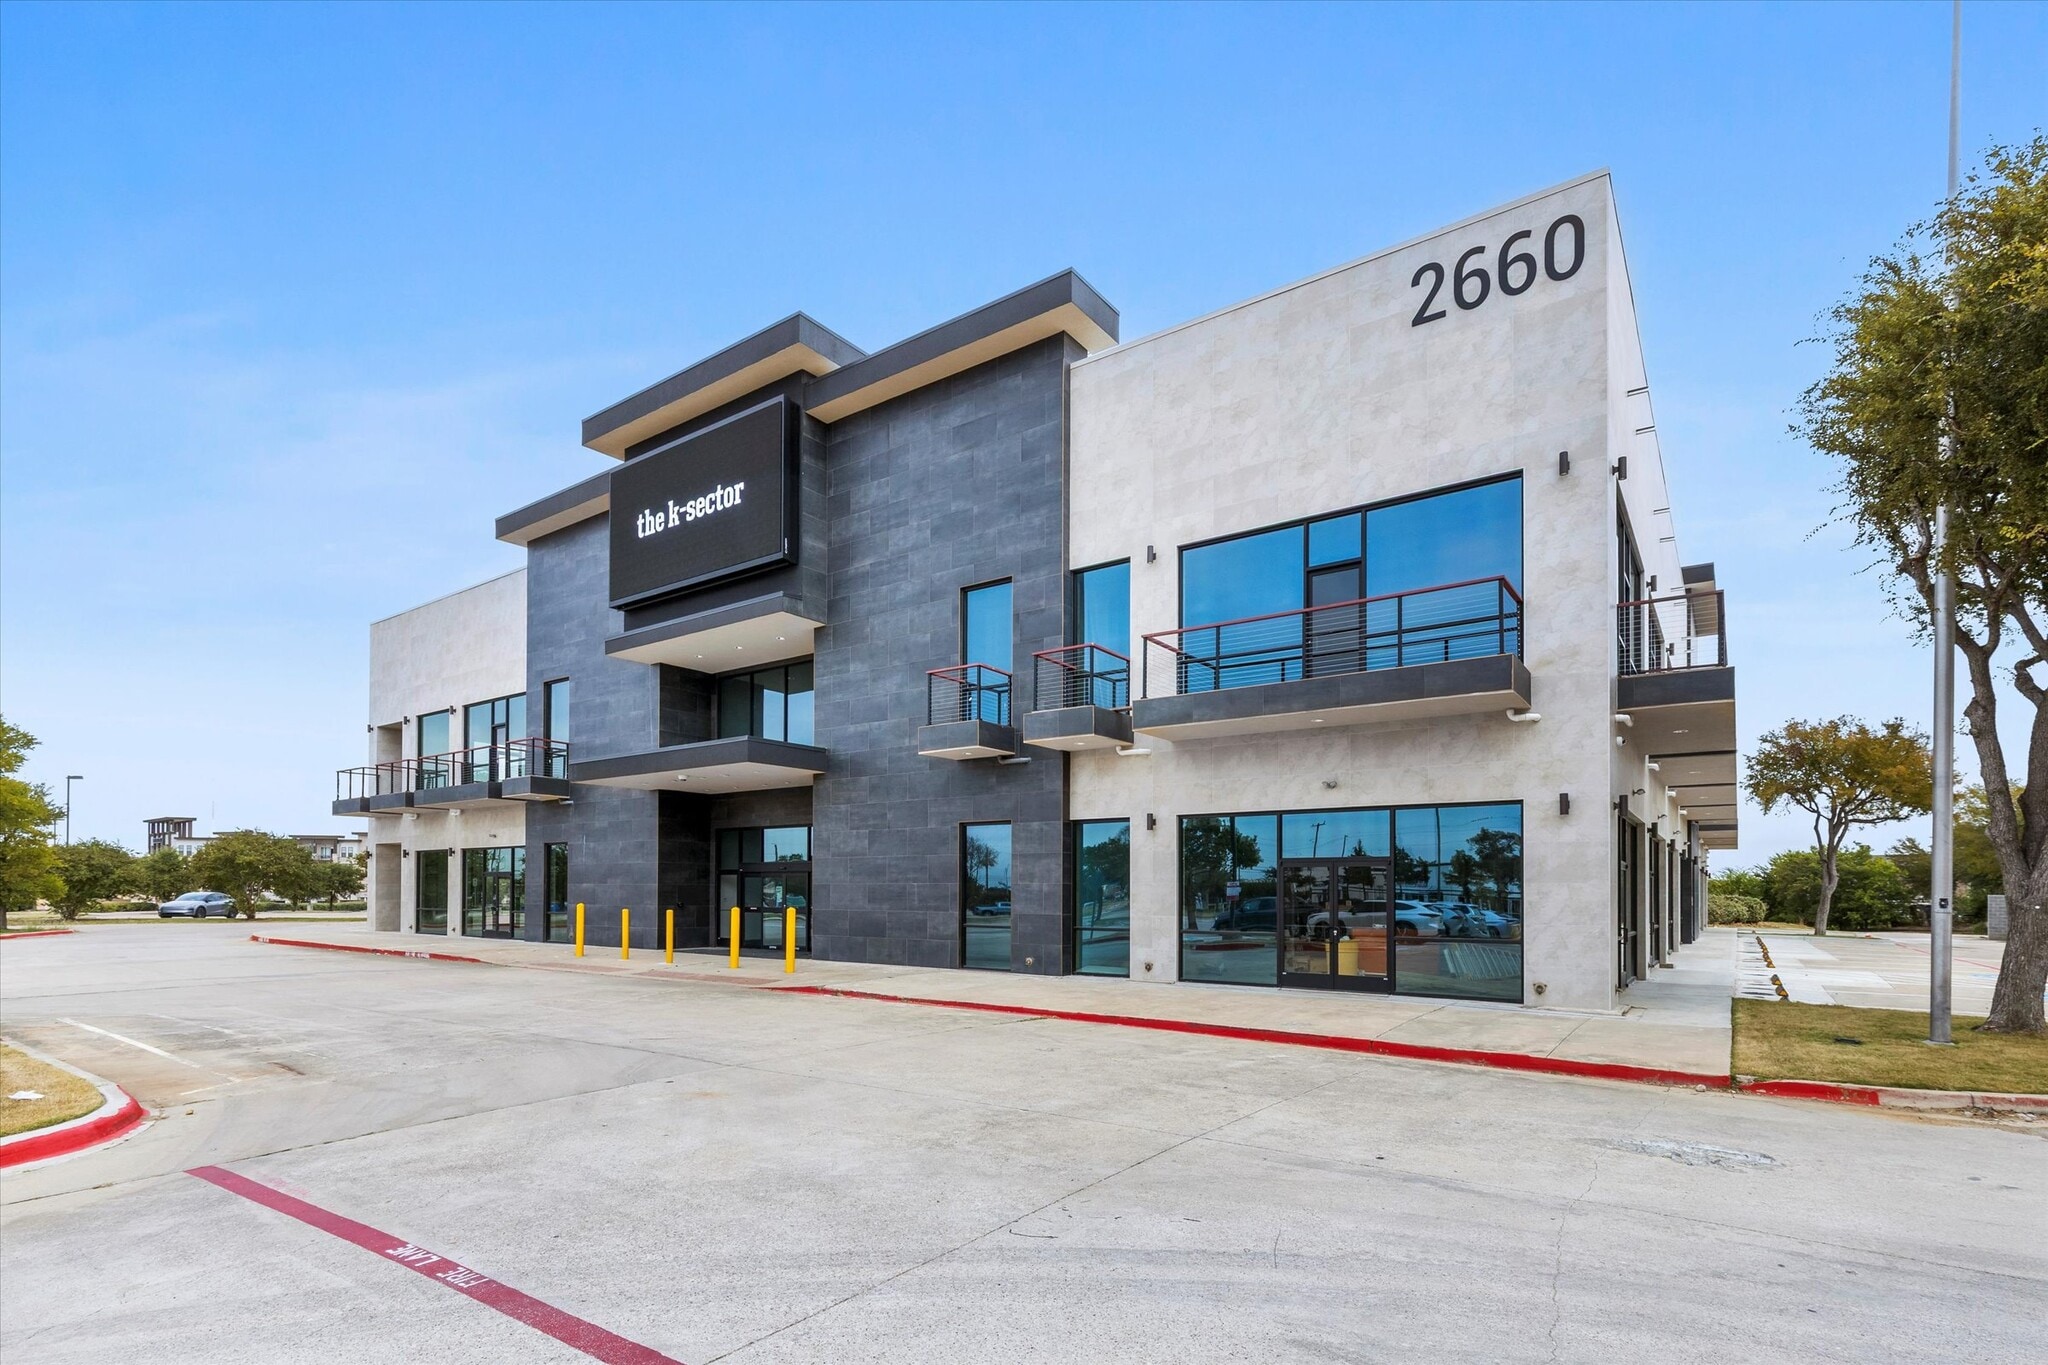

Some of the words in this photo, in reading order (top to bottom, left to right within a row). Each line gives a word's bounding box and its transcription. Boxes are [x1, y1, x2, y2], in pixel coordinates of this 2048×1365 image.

[1410, 214, 1585, 327] 2660
[637, 509, 665, 538] the
[667, 482, 745, 528] k-sector
[385, 1243, 442, 1267] LANE
[435, 1266, 490, 1288] FIRE
